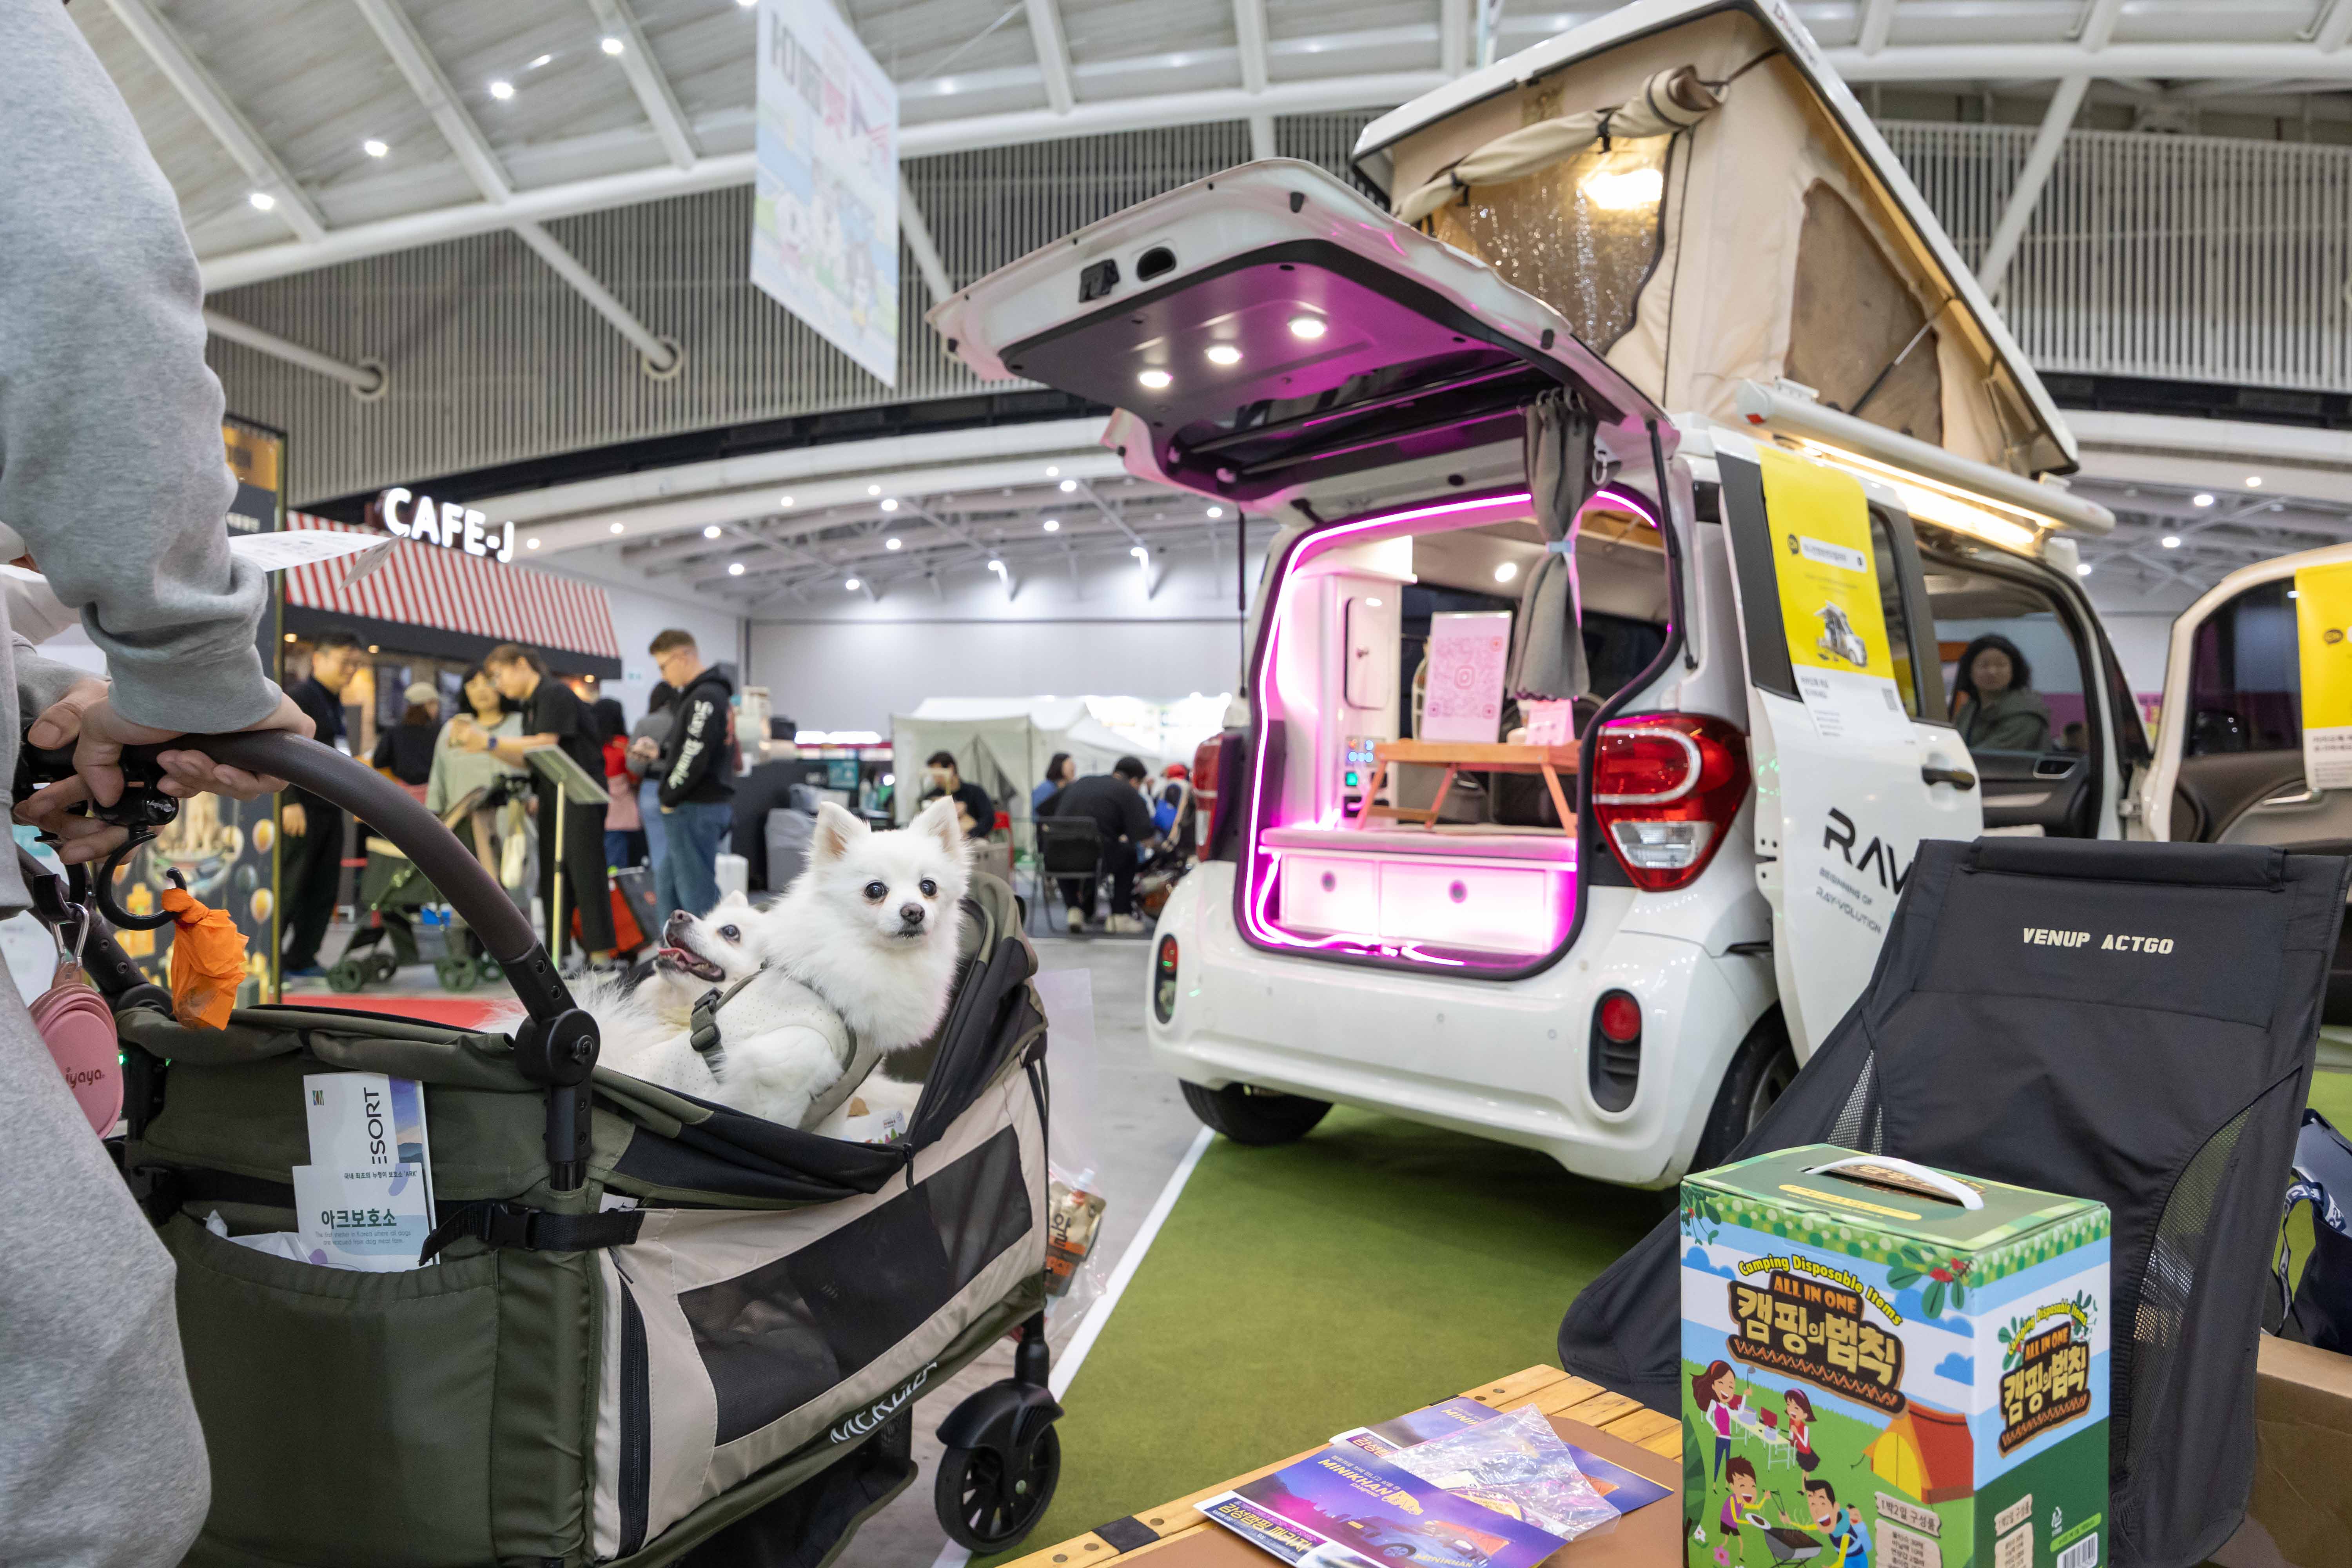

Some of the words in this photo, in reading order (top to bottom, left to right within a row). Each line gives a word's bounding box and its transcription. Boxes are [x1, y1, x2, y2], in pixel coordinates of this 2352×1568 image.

[2023, 927, 2091, 948] VENUP
[2100, 934, 2174, 955] ACTGO
[321, 1208, 397, 1230] 아크보호소
[1739, 1254, 1790, 1276] Camping
[1791, 1254, 1864, 1294] Disposable
[1865, 1286, 1903, 1326] Items
[1774, 1275, 1801, 1298] ALL
[1804, 1283, 1822, 1304] IN
[1824, 1290, 1857, 1314] ONE
[2007, 1315, 2036, 1356] Camping
[2036, 1298, 2071, 1323] Disposable
[2071, 1302, 2087, 1327] Items
[2025, 1340, 2039, 1361] ALL
[2041, 1335, 2051, 1352] IN
[2051, 1327, 2069, 1348] ONE
[1318, 1459, 1393, 1495] MINIKHAN
[1350, 1483, 1379, 1497] CAMPING
[1218, 1503, 1274, 1532] 감성캠핑
[1269, 1525, 1312, 1552] 패키지
[1882, 1500, 1907, 1519] 1박2일
[1910, 1510, 1935, 1531] 구성품
[1414, 1553, 1474, 1568] MINIKHAN
